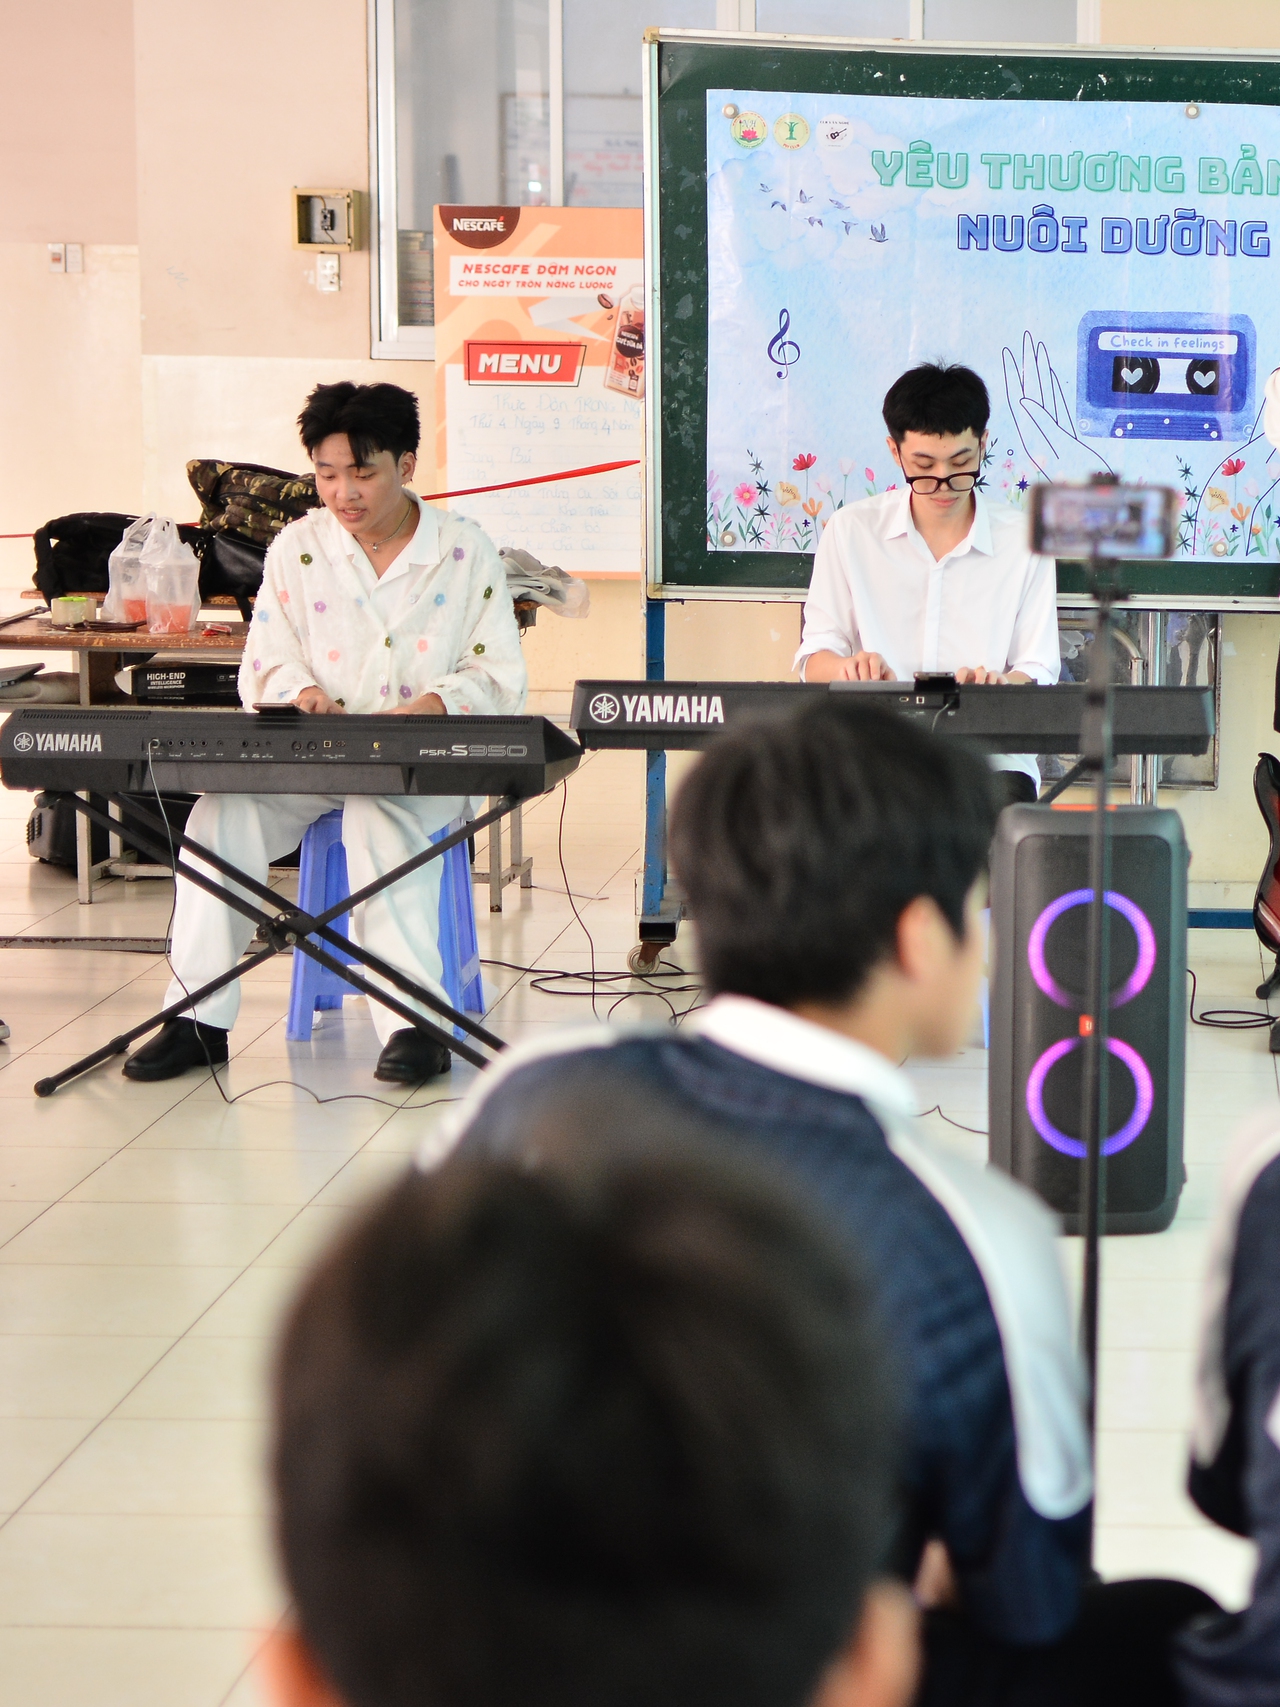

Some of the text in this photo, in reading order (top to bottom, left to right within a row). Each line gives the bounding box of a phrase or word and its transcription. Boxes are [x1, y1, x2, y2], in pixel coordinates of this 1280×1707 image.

[871, 140, 969, 189] YÊU
[981, 150, 1185, 194] THƯƠNG
[453, 216, 505, 232] NESCAFÉ
[957, 203, 1088, 254] NUÔI
[1101, 208, 1270, 258] DƯỠNG
[574, 265, 617, 276] NGON
[458, 280, 480, 288] CHO
[1110, 335, 1226, 353] Check in feelings
[478, 353, 562, 374] MENU
[146, 672, 186, 681] HIGH-END
[622, 695, 724, 724] YAMAHA
[36, 733, 102, 752] YAMAHA
[419, 744, 528, 758] PSR-S950
